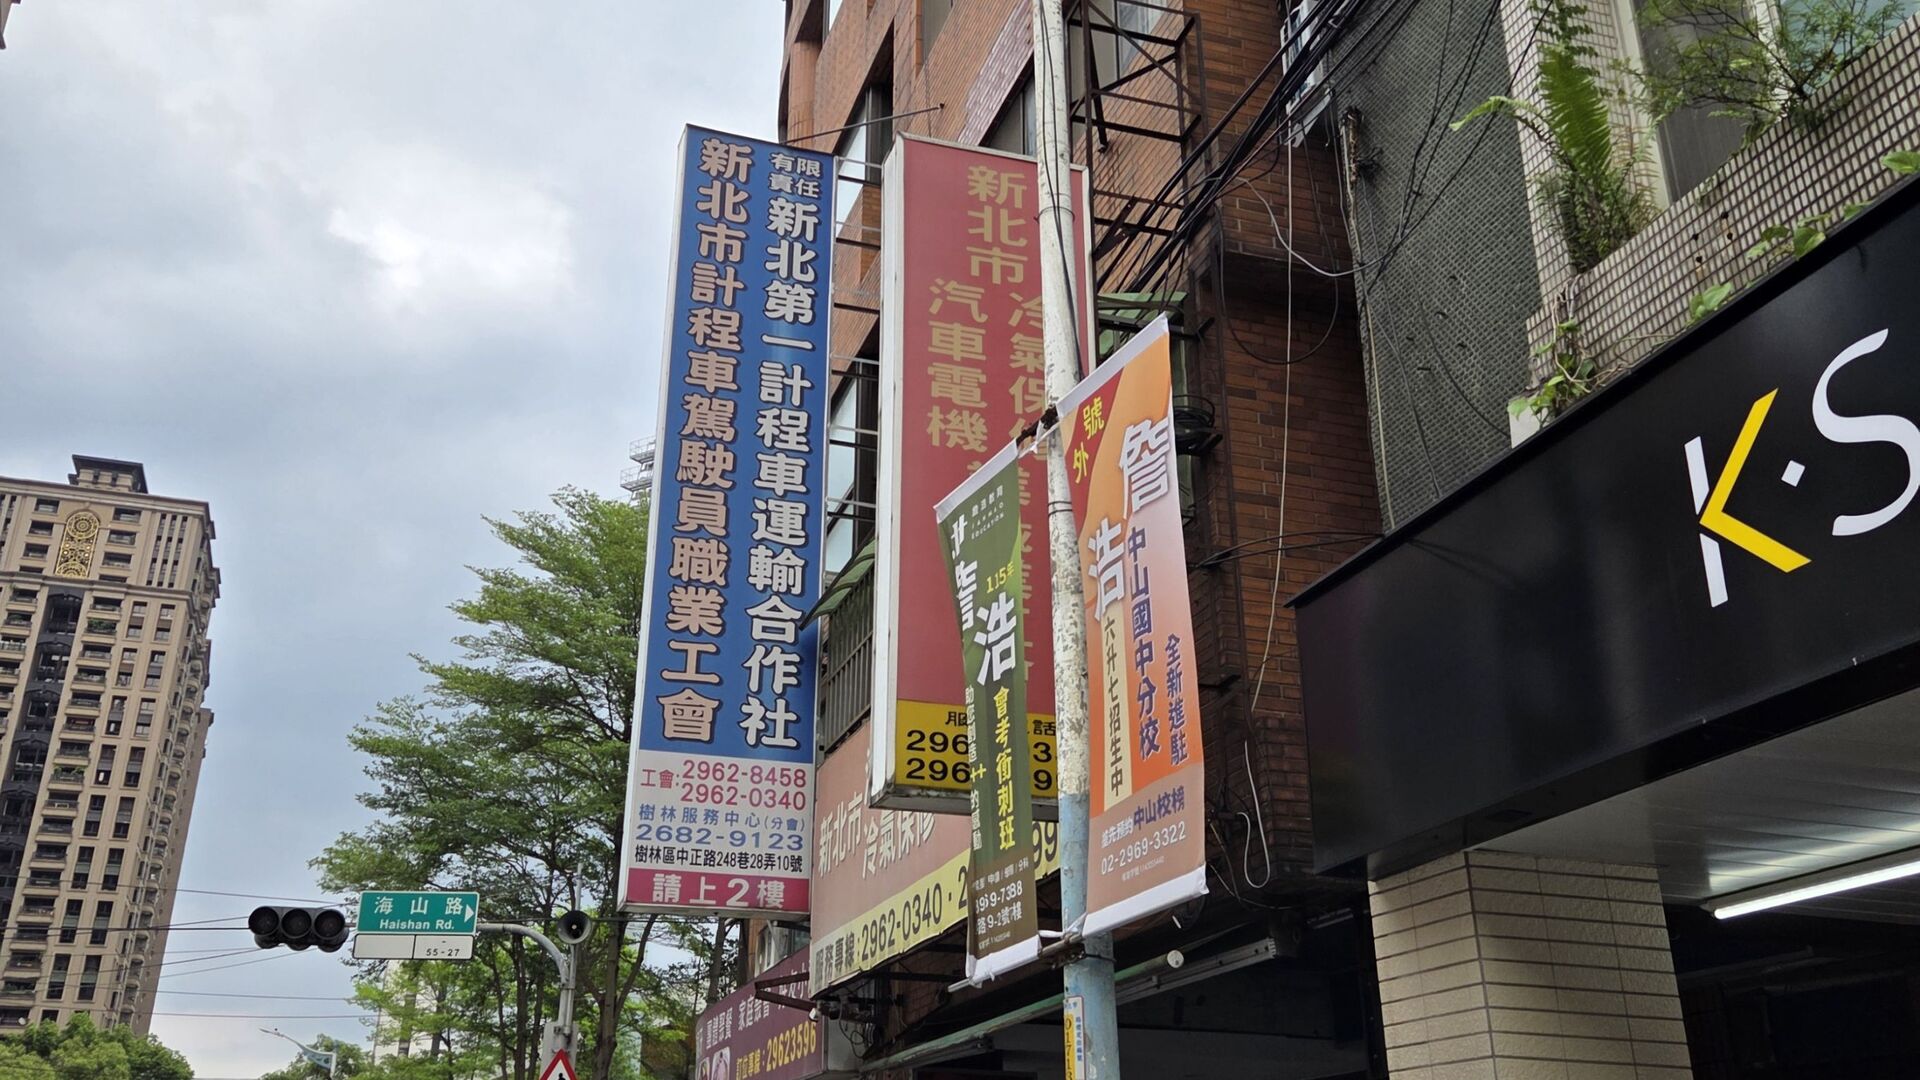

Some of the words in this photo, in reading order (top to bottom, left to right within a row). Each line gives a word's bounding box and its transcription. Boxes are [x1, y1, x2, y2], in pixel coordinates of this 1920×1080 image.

[966, 165, 1028, 285] 新北市
[657, 138, 752, 742] 新北市計程車駕駛員職業工會
[739, 198, 819, 748] 新北第一計程車運輸合作社
[1127, 526, 1161, 761] 中山國中分校
[1104, 616, 1123, 797] 六升七招生中
[1164, 633, 1189, 767] 全新進駐
[682, 759, 807, 788] 2962-8458
[680, 782, 807, 811] 2962-0340
[634, 844, 803, 873] 樹林區中正路248巷28弄10號
[635, 823, 804, 851] 2682-9123
[1101, 821, 1186, 875] 02-2969-3322
[374, 896, 462, 915] 海山路
[652, 873, 786, 909] 請上2樓
[379, 919, 430, 930] Haishan
[435, 919, 455, 930] Rd.
